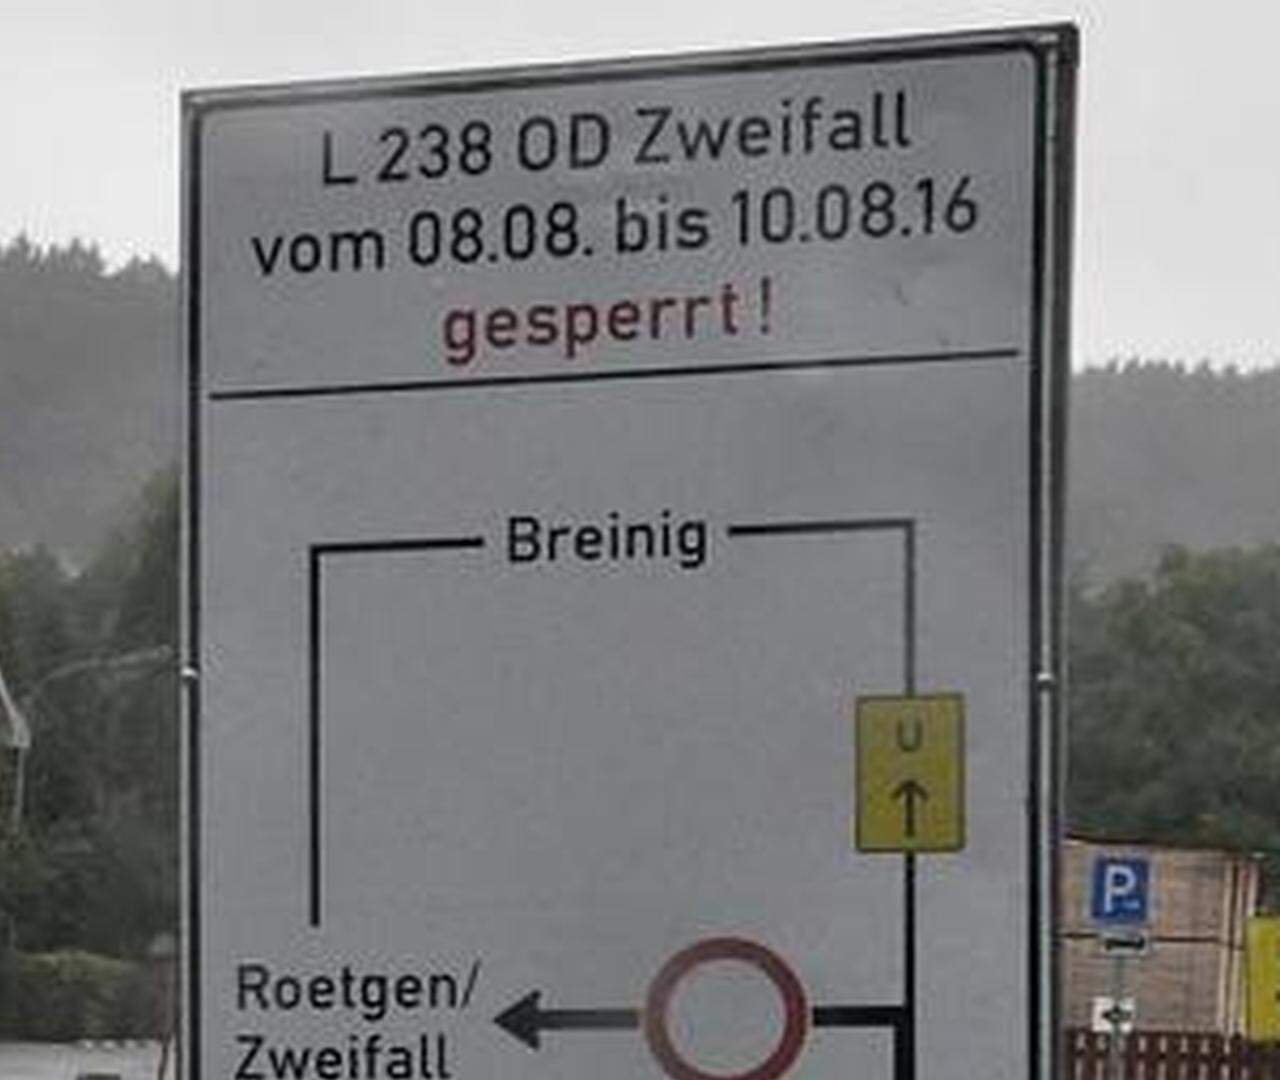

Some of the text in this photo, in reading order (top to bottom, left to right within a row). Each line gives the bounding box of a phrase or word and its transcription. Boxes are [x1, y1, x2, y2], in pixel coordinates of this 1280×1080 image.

[323, 90, 910, 186] L 238 OD Zweifall
[252, 176, 977, 275] vom 08.08. bis 10.08.16
[508, 510, 706, 569] Breinig
[896, 719, 923, 753] U
[1105, 866, 1137, 914] P
[238, 963, 478, 1019] Roetgen/
[235, 1034, 450, 1080] Zweifall
